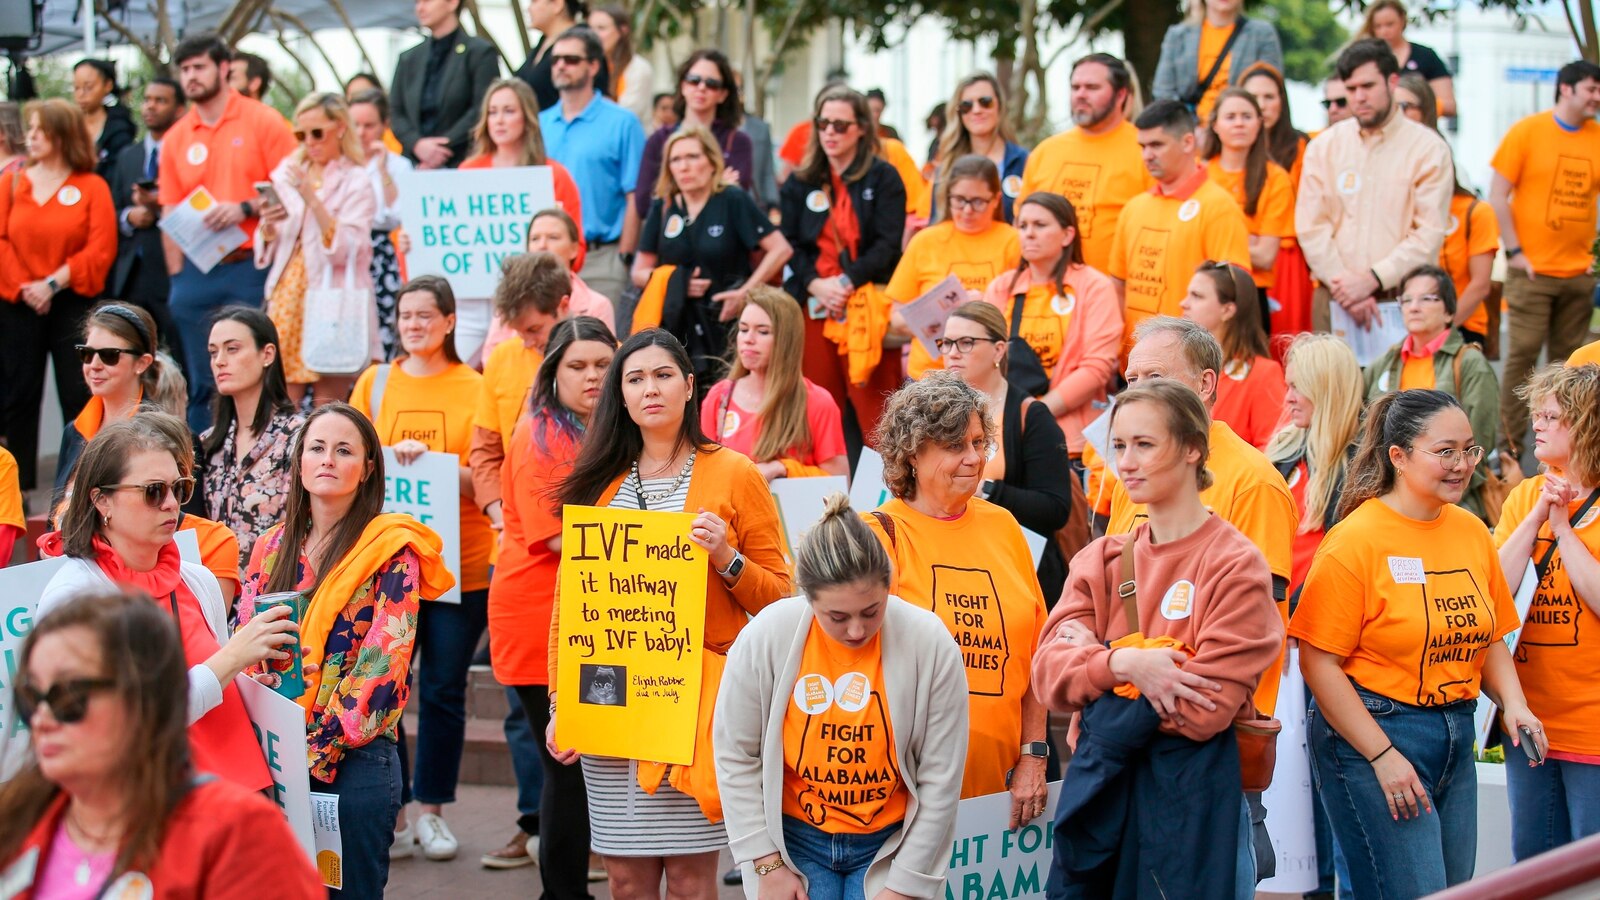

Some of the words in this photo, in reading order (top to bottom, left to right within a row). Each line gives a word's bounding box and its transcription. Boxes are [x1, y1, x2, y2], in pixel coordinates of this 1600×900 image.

[422, 195, 456, 218] I'M
[468, 192, 532, 217] HERE
[422, 222, 529, 246] BECAUS
[442, 252, 472, 274] OF
[402, 430, 437, 440] FIGHT
[646, 536, 694, 560] made
[1392, 559, 1417, 570] PRESS
[580, 571, 598, 594] it
[609, 572, 678, 608] halfway
[945, 592, 988, 610] FIGHT
[1434, 594, 1478, 612] FIGHT
[582, 602, 600, 622] to
[607, 606, 676, 634] meeting
[954, 612, 984, 628] FOR
[1445, 613, 1478, 629] FOR
[568, 634, 595, 658] my
[605, 629, 638, 650] IVF
[644, 628, 692, 660] baby!
[1428, 632, 1491, 650] ALABAMA
[632, 674, 658, 690] Elijah
[662, 689, 680, 704] July
[820, 723, 874, 742] FIGHT
[826, 746, 866, 764] FOR
[802, 766, 891, 786] ALABAMA
